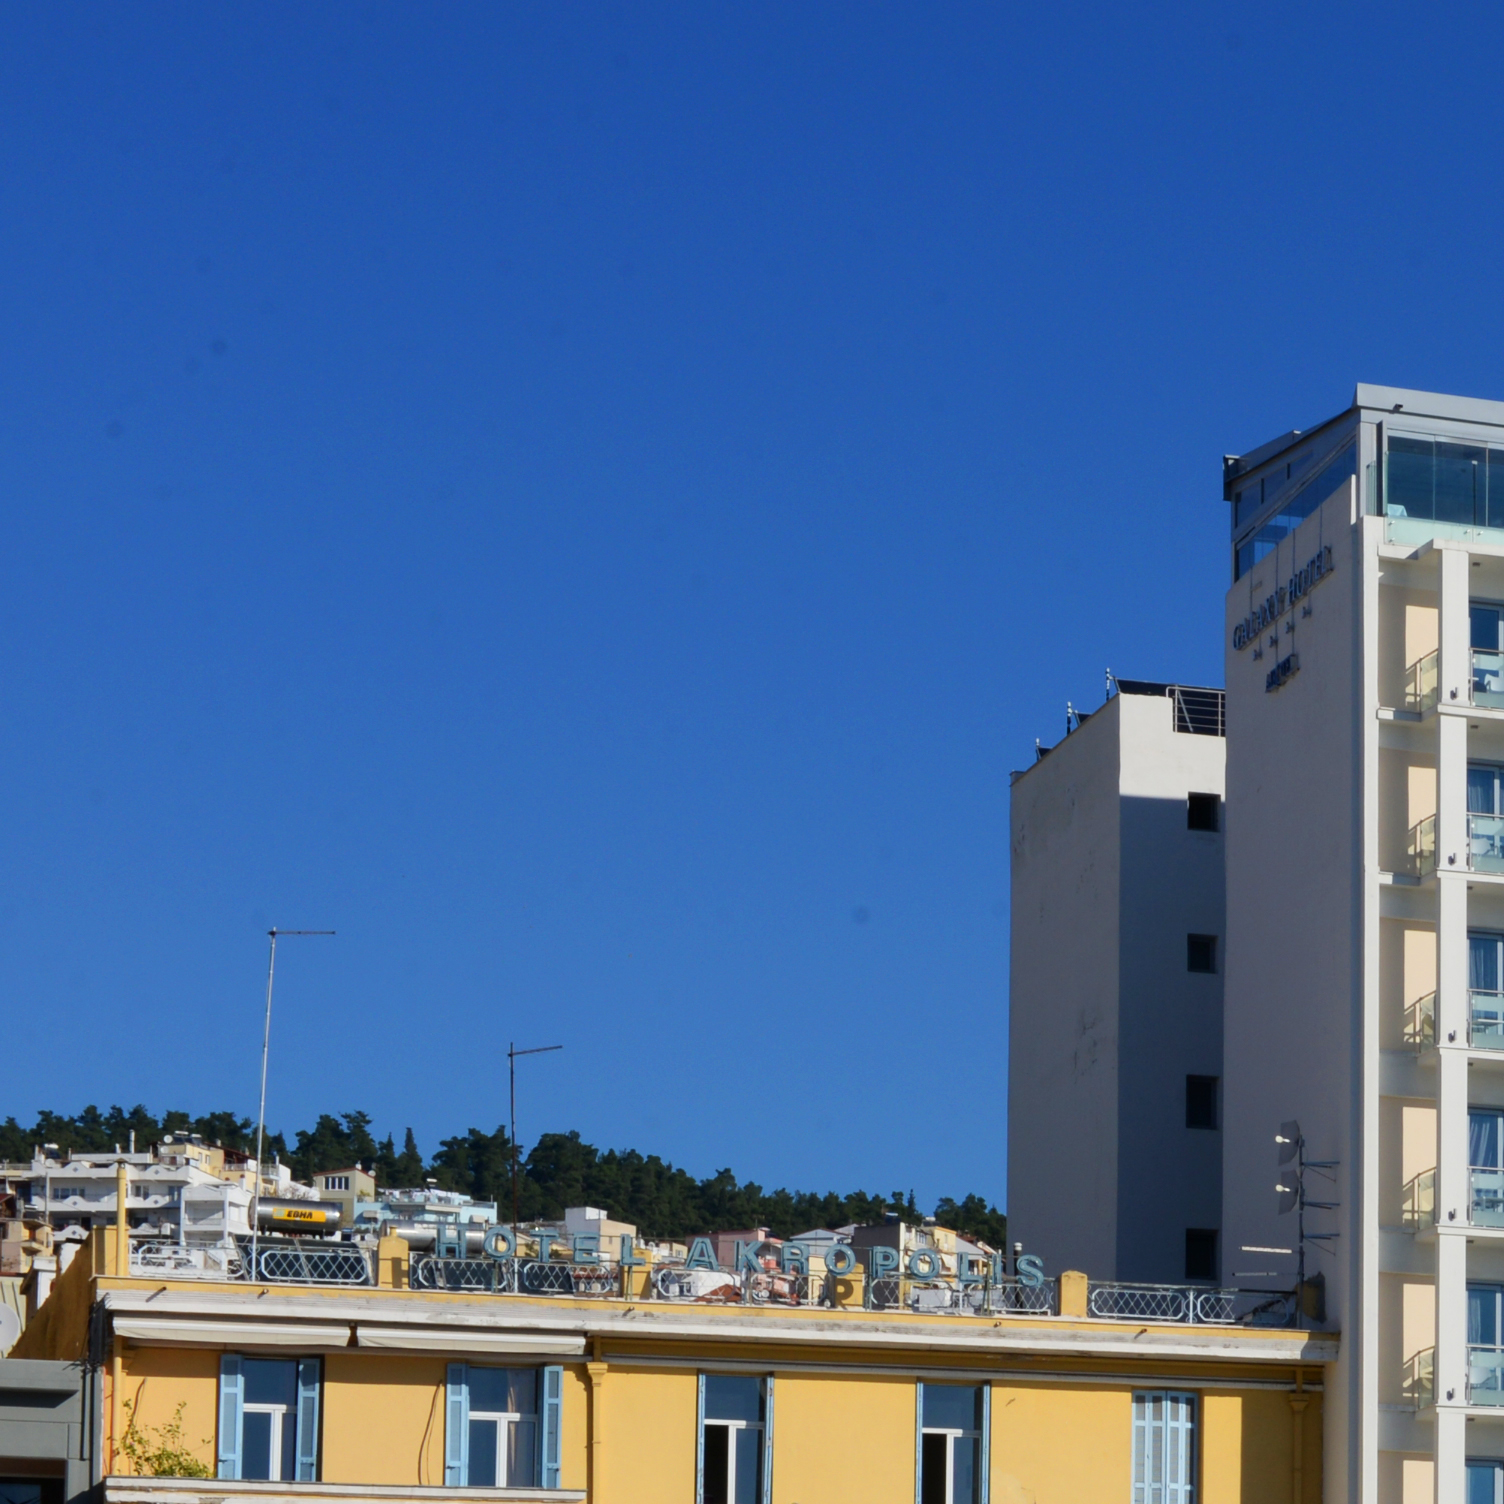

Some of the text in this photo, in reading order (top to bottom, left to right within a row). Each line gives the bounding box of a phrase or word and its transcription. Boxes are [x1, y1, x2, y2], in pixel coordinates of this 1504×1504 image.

[1233, 546, 1332, 650] GALAXY HOTEL
[435, 1223, 1045, 1287] HOTEL AKROPOLIS
